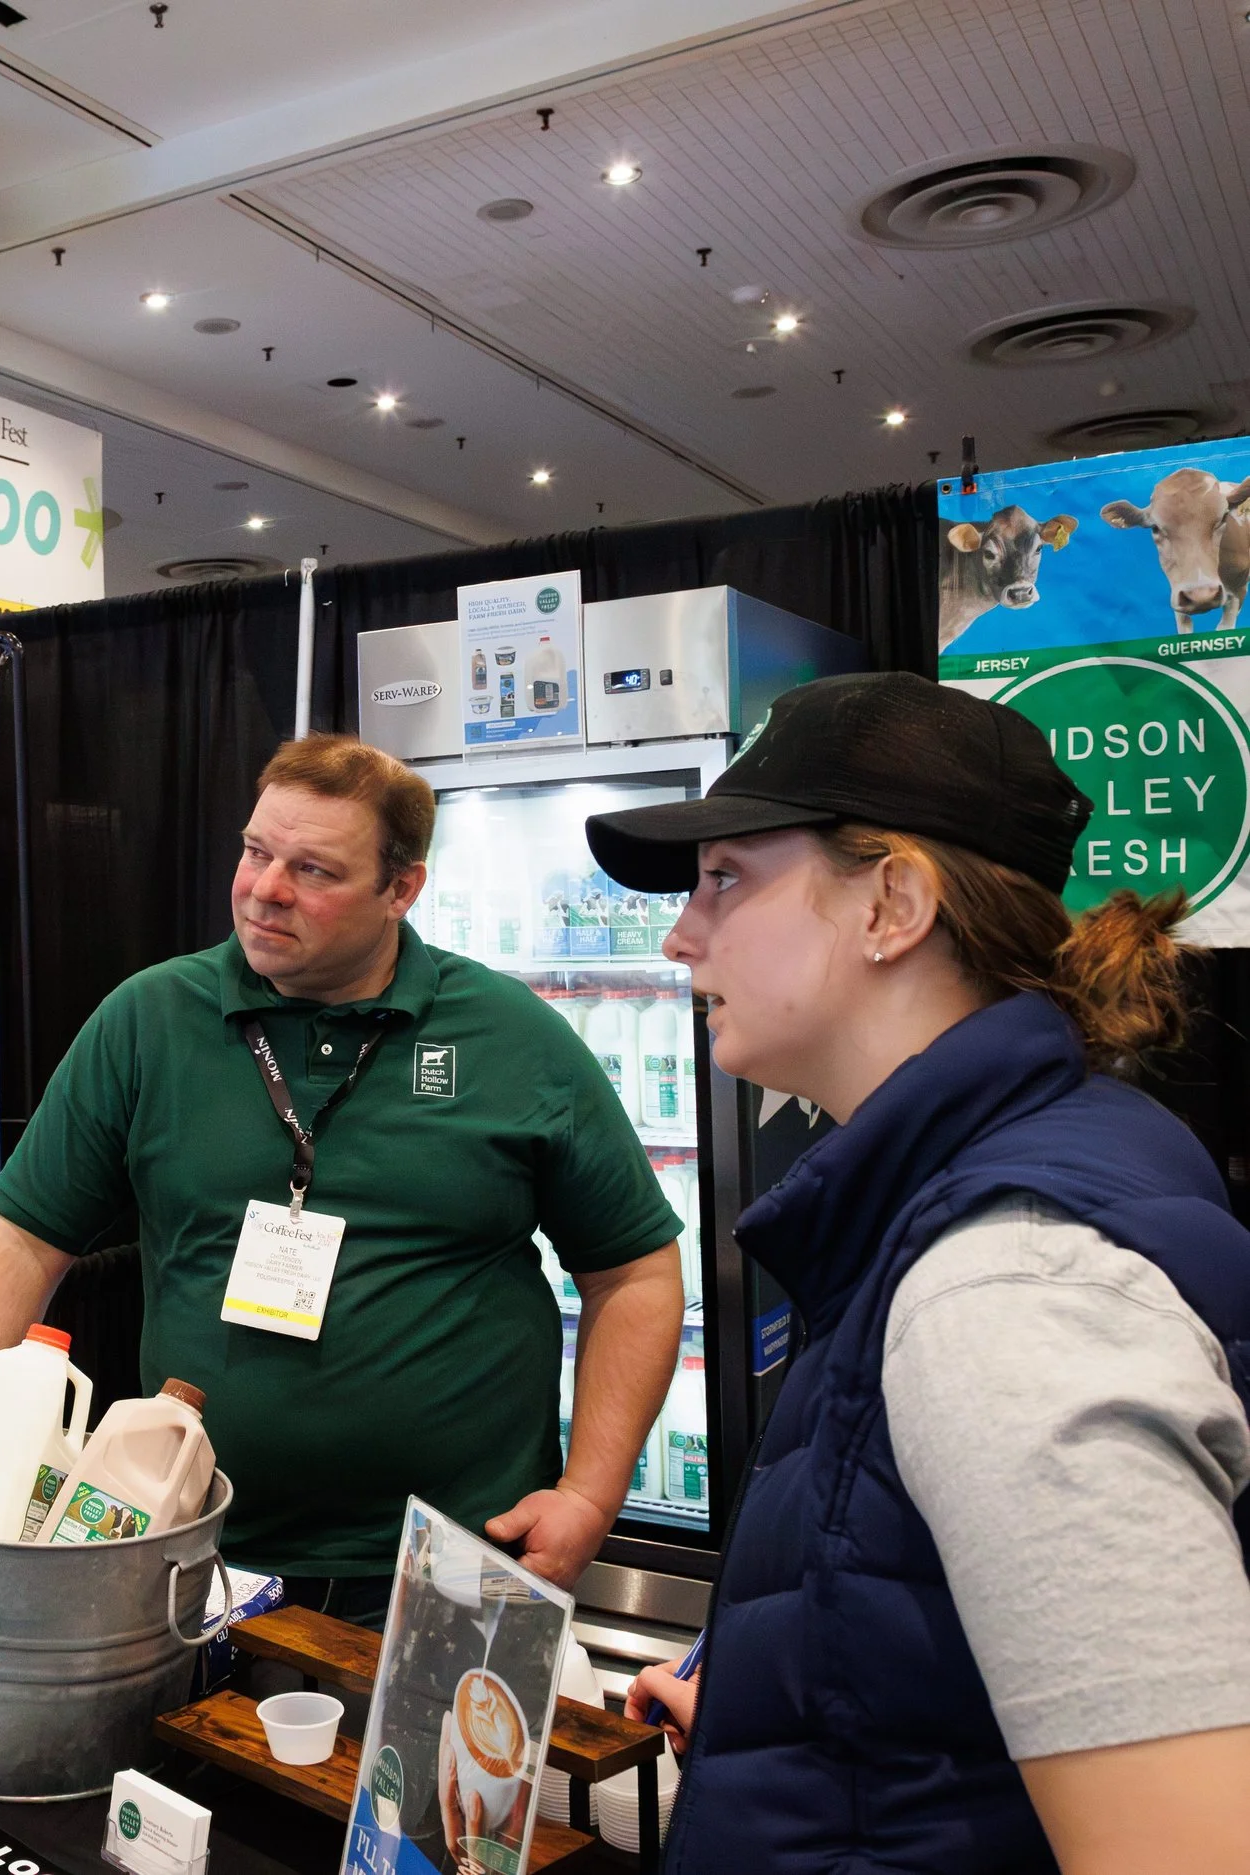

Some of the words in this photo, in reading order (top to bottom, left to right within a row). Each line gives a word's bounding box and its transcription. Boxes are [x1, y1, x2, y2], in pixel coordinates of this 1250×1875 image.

[1157, 635, 1246, 657] GUERNSEY
[973, 656, 1030, 674] JERSEY
[373, 686, 433, 701] SERV-WARE
[1051, 718, 1205, 760] DSON
[1107, 775, 1216, 816] LEY
[1070, 838, 1186, 877] ESH
[257, 1037, 282, 1082] MONIN
[421, 1075, 449, 1084] Hollow
[421, 1083, 442, 1092] Farm
[279, 1246, 297, 1256] NATE
[256, 1306, 288, 1318] EXHIBITOR
[85, 1505, 101, 1515] VALLEY
[267, 1585, 283, 1600] 500
[121, 1814, 139, 1826] VALLEY
